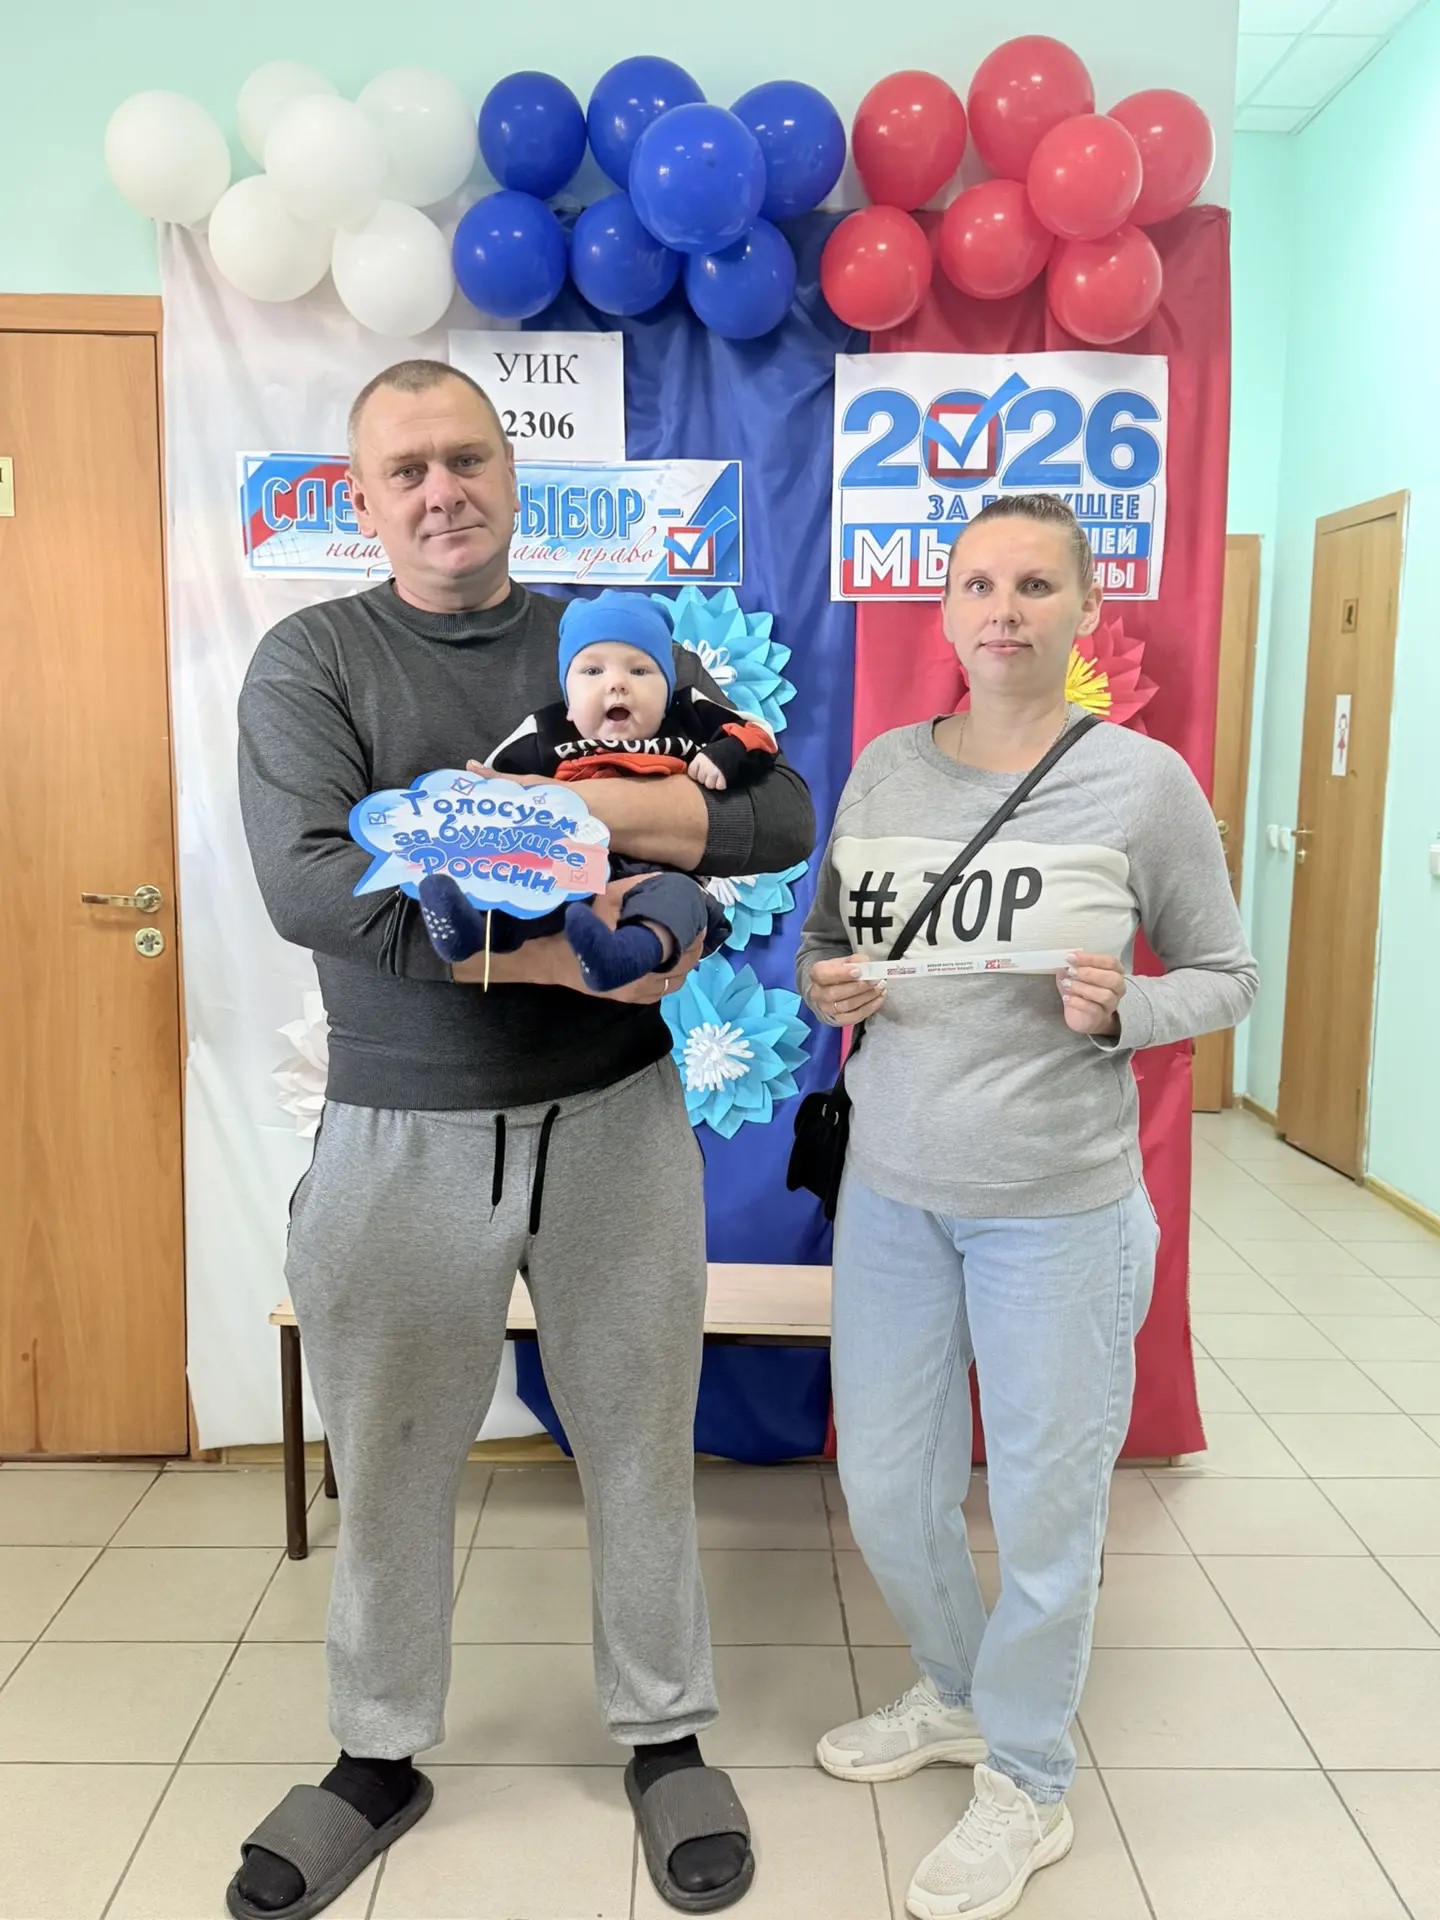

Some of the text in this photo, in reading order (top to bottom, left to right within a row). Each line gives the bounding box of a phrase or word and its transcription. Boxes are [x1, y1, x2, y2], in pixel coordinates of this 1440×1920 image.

[493, 352, 580, 384] УИК
[502, 410, 574, 439] 2306
[838, 387, 1162, 491] 2026
[262, 477, 359, 533] СДЕ
[513, 484, 645, 540] ЫБОР
[927, 495, 969, 520] ЗА
[513, 544, 567, 560] аше
[576, 526, 660, 579] право
[399, 789, 578, 835] Голосуем
[392, 814, 587, 868] за будущее
[408, 846, 557, 895] России
